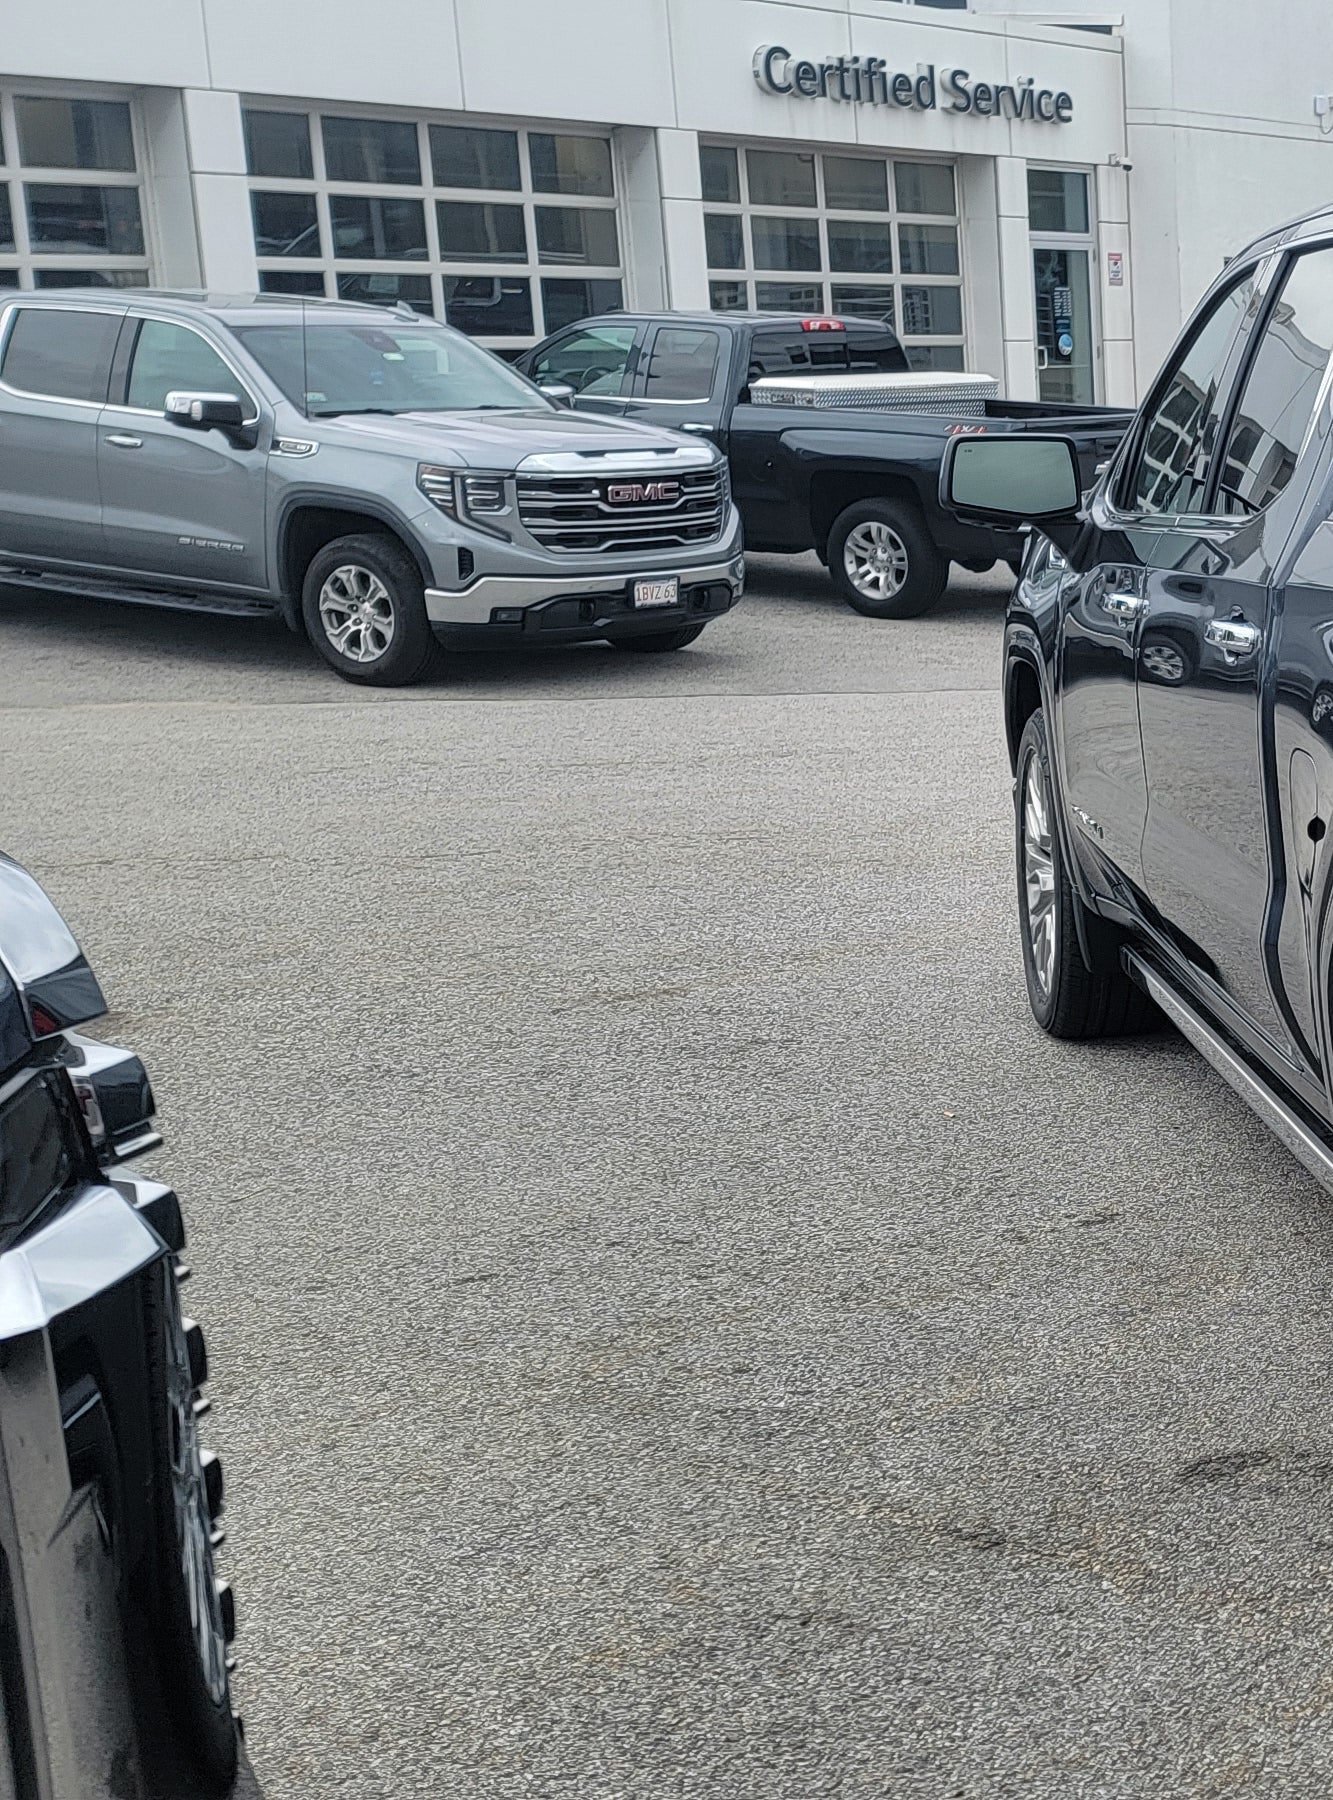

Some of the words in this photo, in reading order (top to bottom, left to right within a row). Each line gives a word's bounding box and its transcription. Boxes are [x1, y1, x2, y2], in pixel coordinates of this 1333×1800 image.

[755, 44, 937, 110] Certified
[943, 68, 1074, 124] Service
[608, 482, 679, 503] GMC
